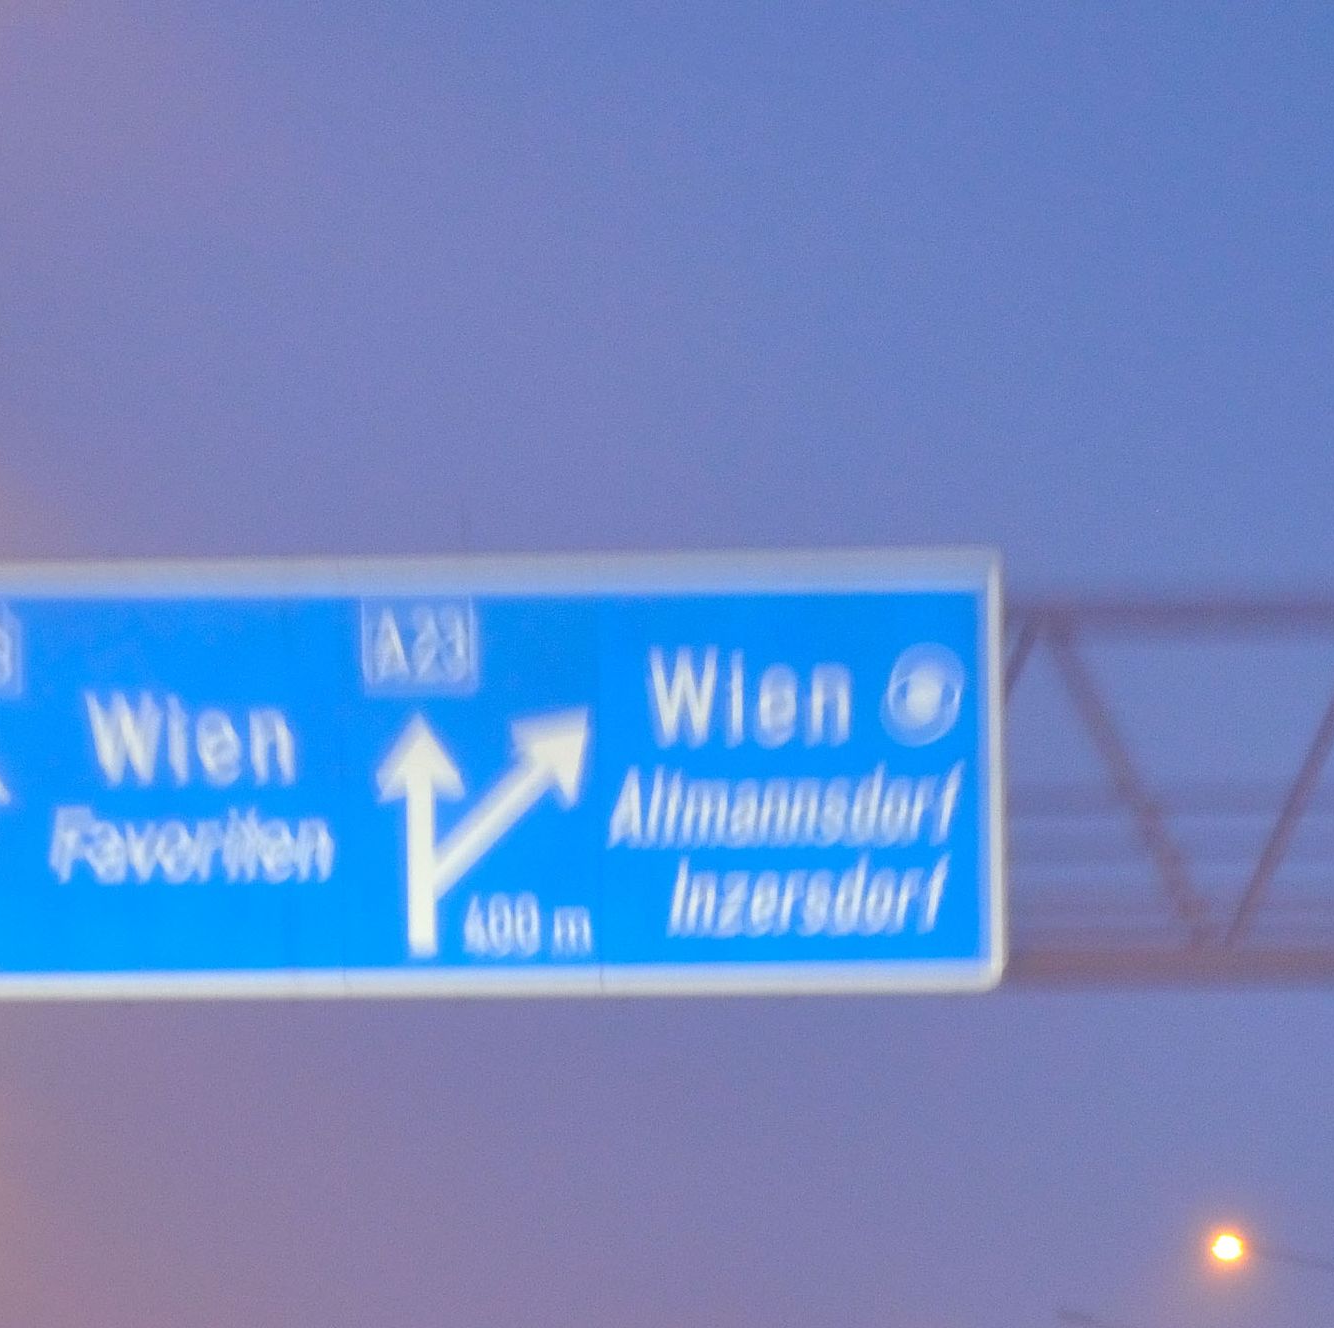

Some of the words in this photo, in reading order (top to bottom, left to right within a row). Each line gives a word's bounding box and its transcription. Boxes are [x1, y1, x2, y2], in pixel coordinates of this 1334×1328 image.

[84, 691, 297, 788] Wien
[647, 644, 853, 748] Wien
[49, 805, 335, 885] Favoriten
[668, 851, 951, 938] Inzersdorf
